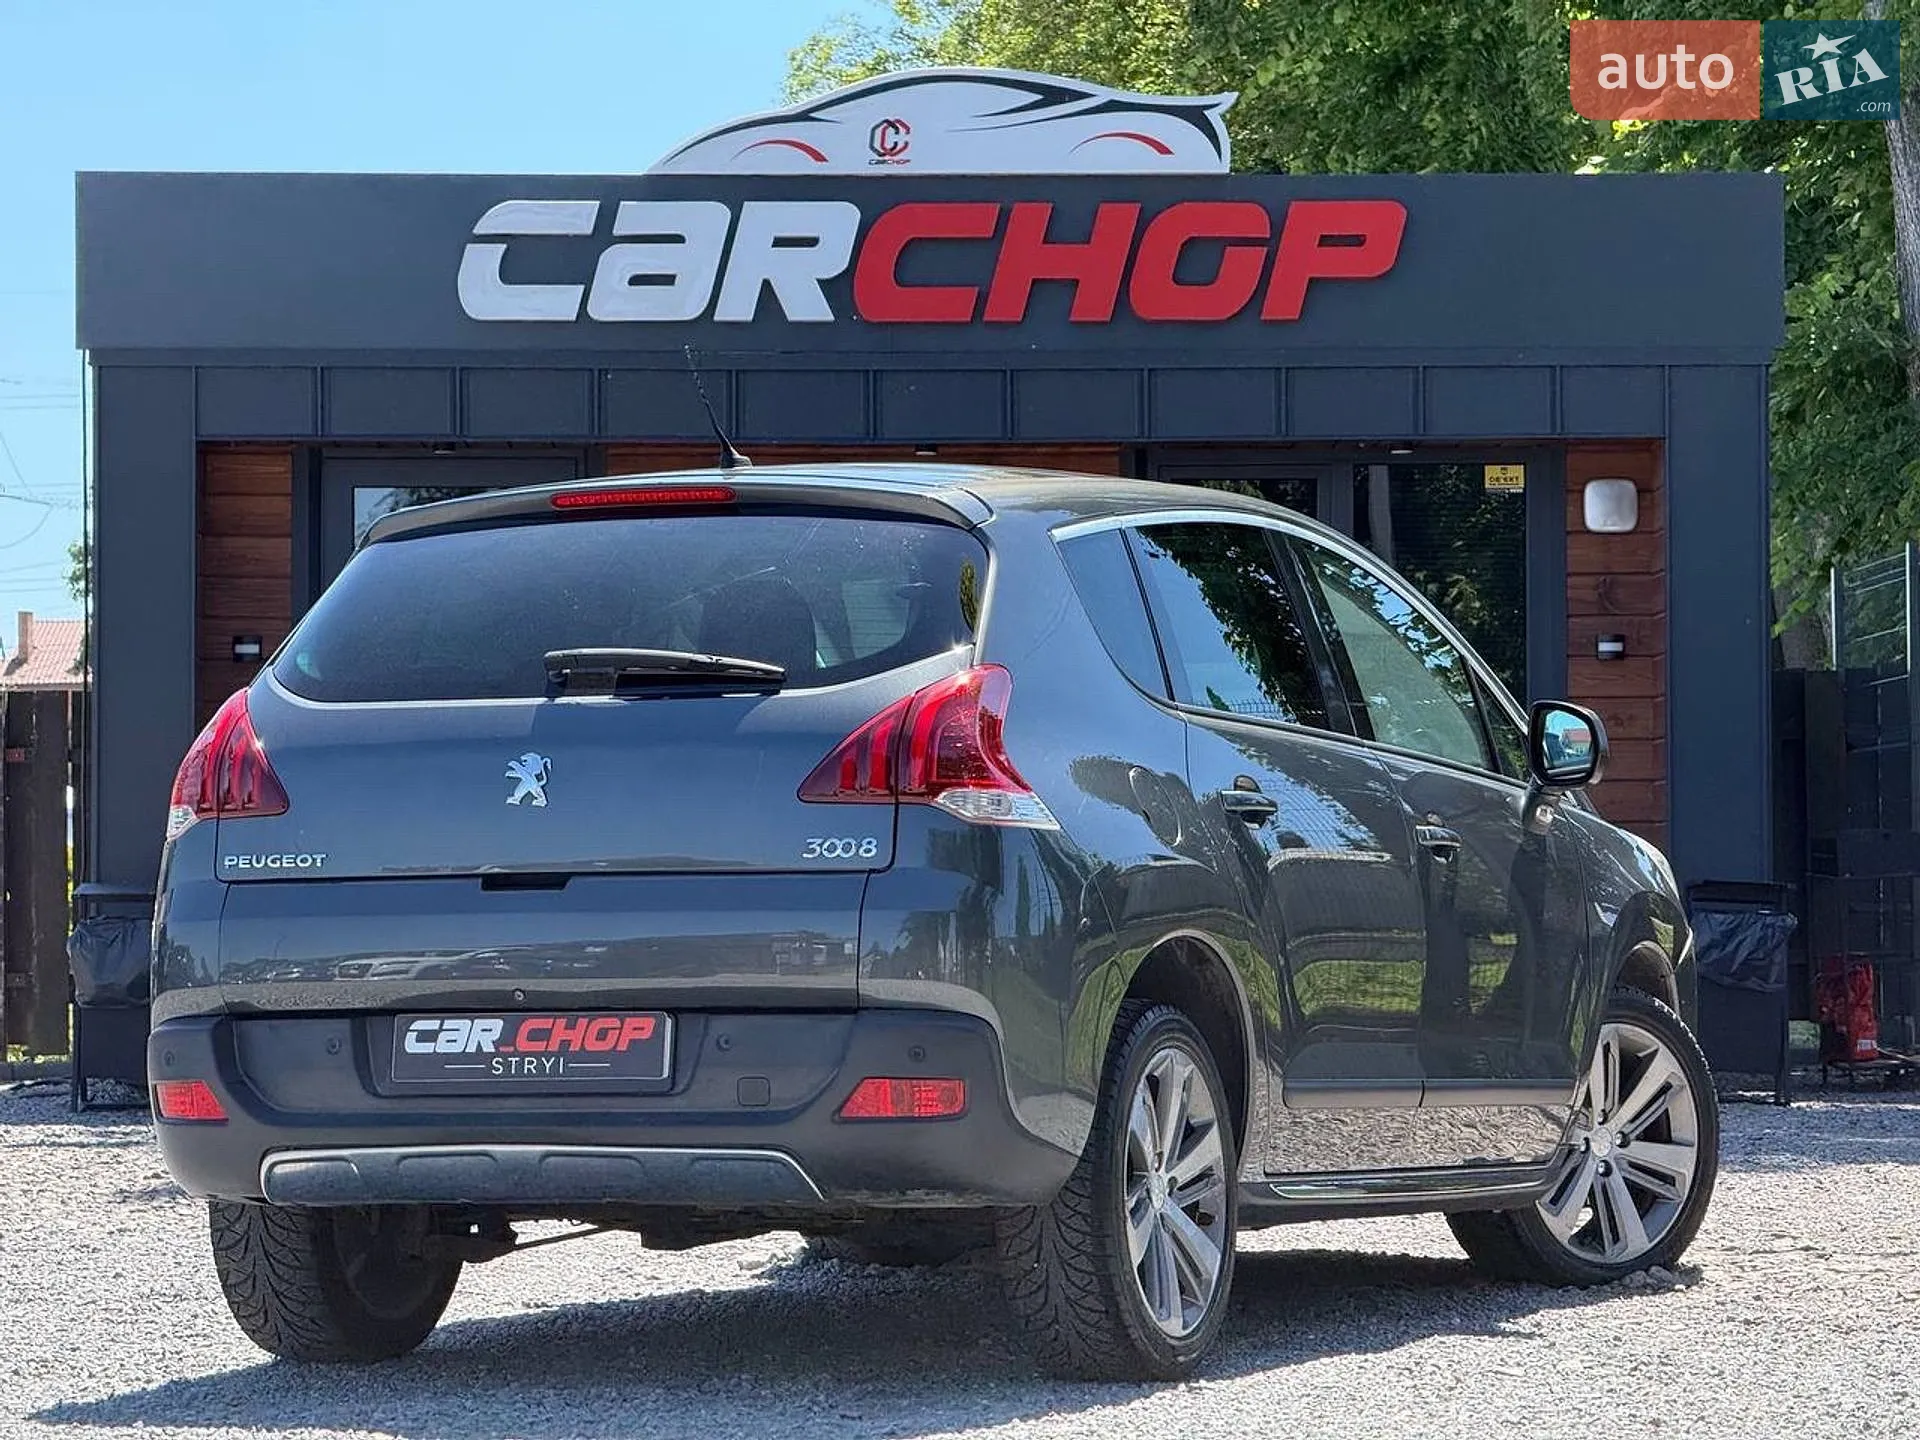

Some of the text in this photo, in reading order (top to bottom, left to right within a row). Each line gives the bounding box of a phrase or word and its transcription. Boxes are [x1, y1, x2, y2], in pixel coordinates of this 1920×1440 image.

[223, 838, 878, 869] PEUGEOT 3008
[491, 1057, 566, 1075] STRYI
